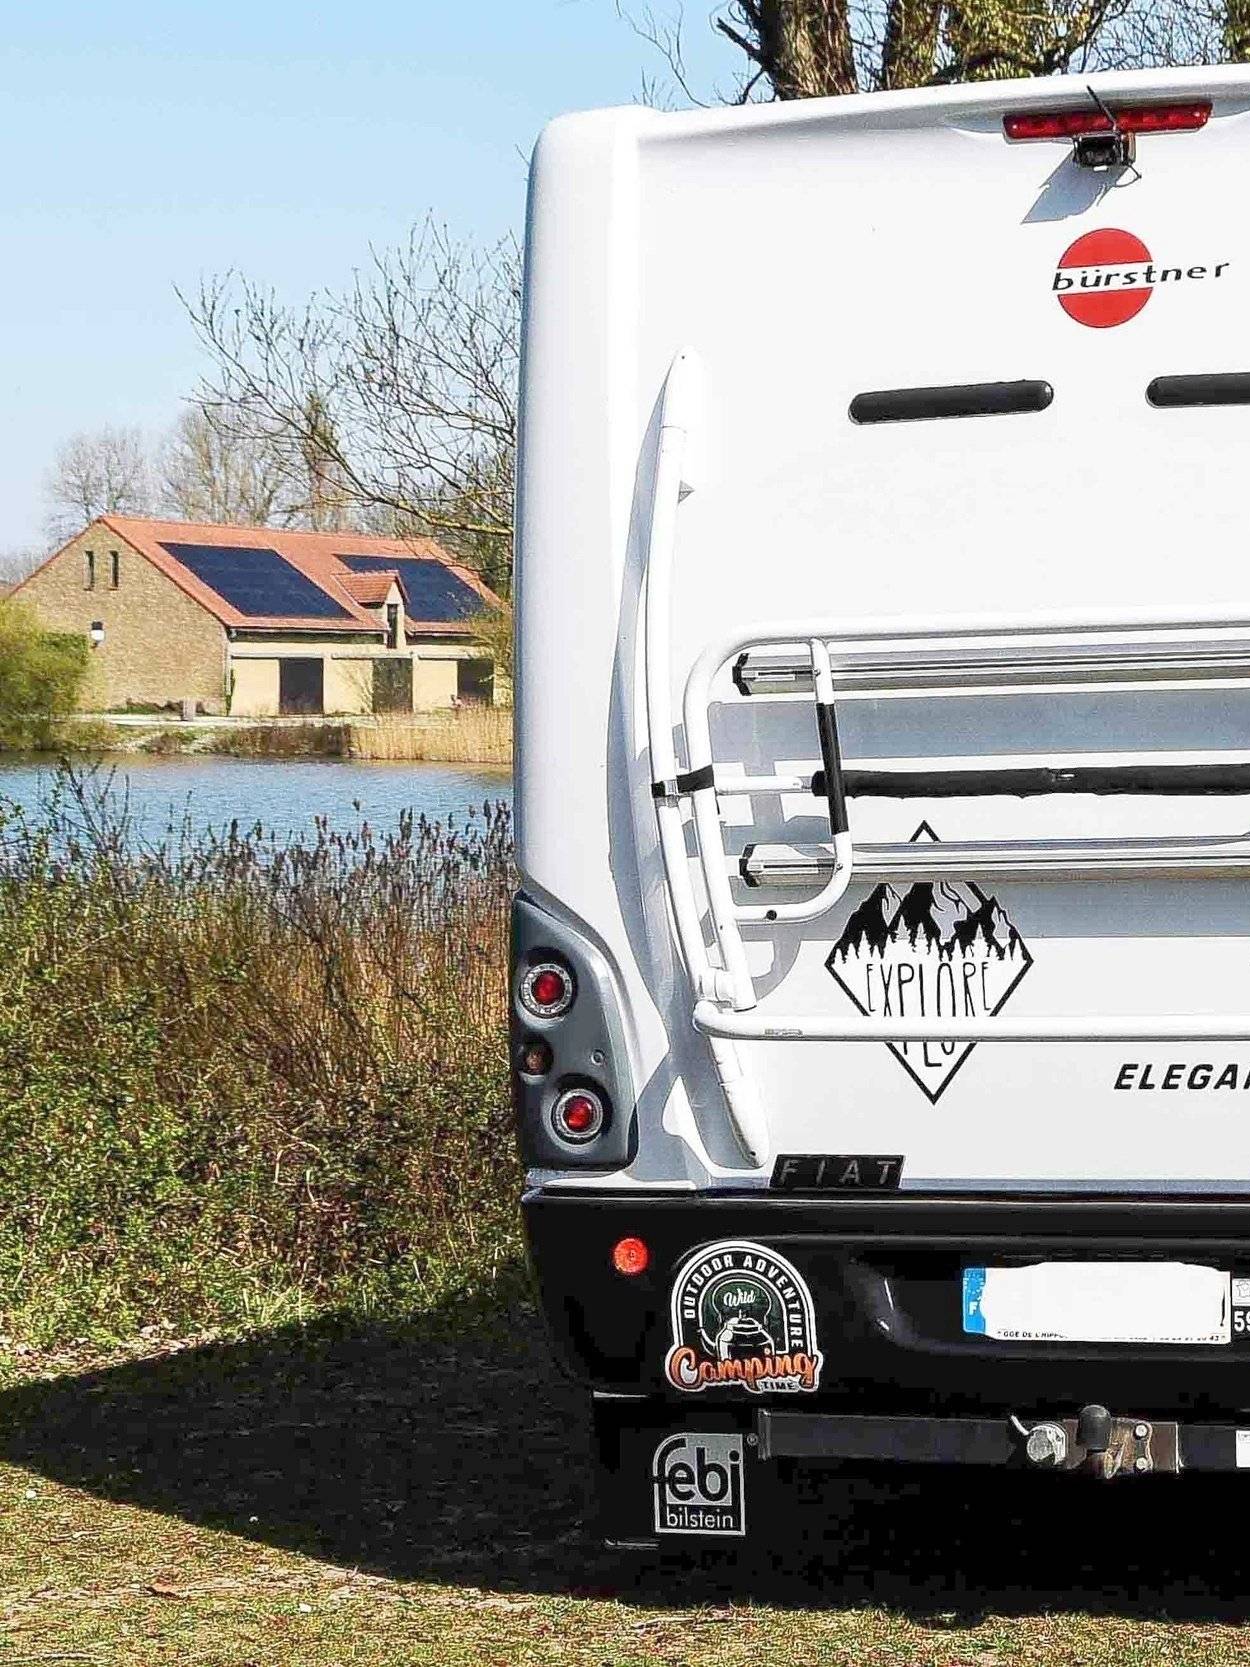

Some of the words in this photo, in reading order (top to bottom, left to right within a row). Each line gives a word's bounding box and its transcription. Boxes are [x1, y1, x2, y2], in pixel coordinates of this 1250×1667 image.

[1052, 262, 1230, 291] bürstner
[866, 962, 992, 1067] EXPLORE
[779, 1159, 897, 1186] FIAT
[683, 1254, 734, 1320] OUTDOOR
[742, 1254, 804, 1348] ADVENTURE
[723, 1288, 757, 1307] Wild
[968, 1301, 978, 1315] F
[669, 1347, 817, 1390] Camping
[761, 1381, 796, 1391] TIME
[653, 1437, 740, 1505] febi
[666, 1506, 734, 1528] bilstein
